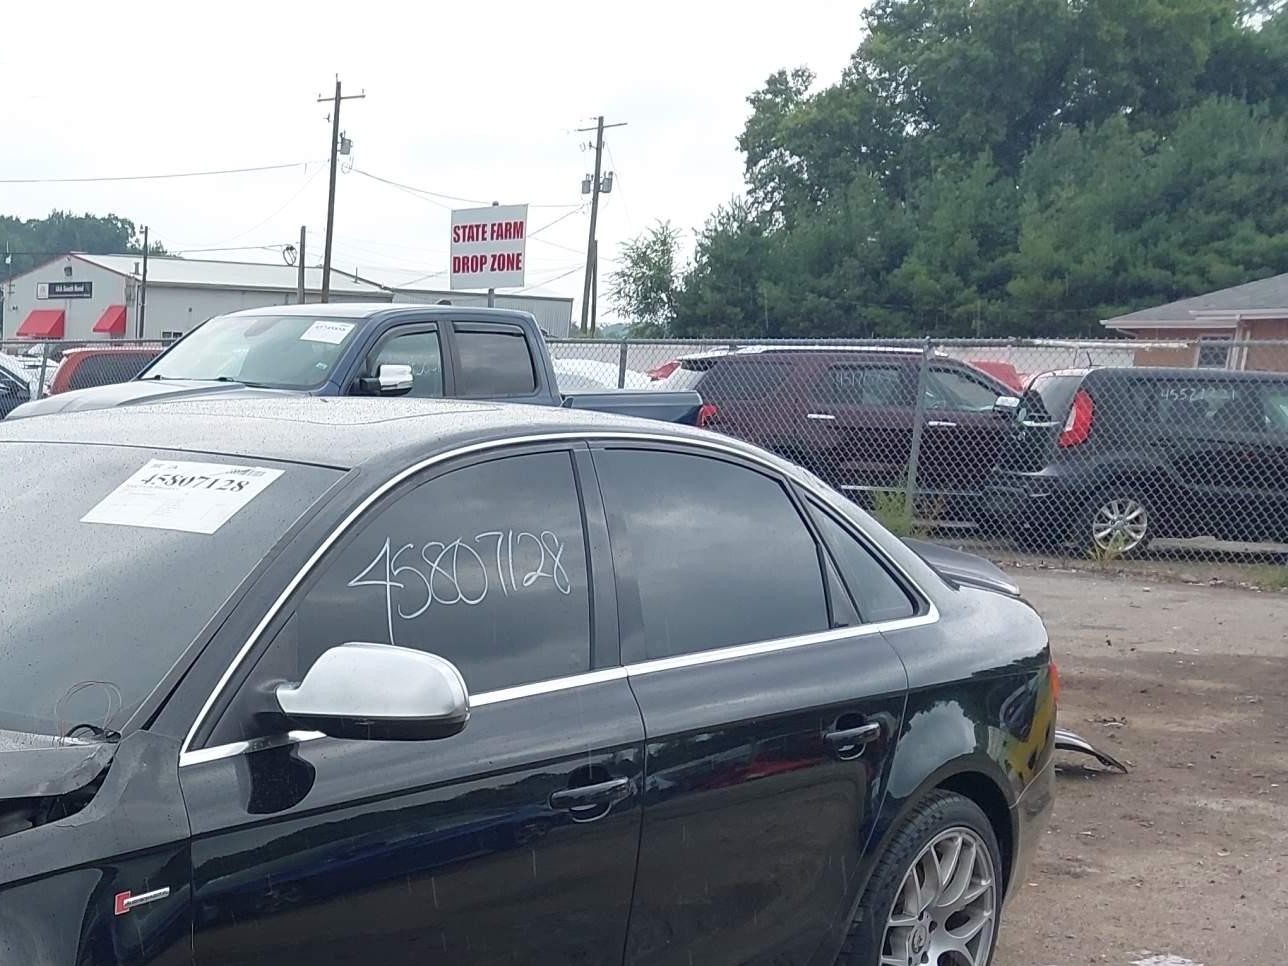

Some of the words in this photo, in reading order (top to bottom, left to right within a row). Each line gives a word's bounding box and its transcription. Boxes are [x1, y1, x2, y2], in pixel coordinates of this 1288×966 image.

[453, 224, 488, 243] STATE
[491, 221, 524, 240] FARM
[453, 255, 488, 274] DROP
[490, 253, 523, 272] ZONE
[141, 473, 250, 493] 45807128
[347, 529, 571, 645] 45807128
